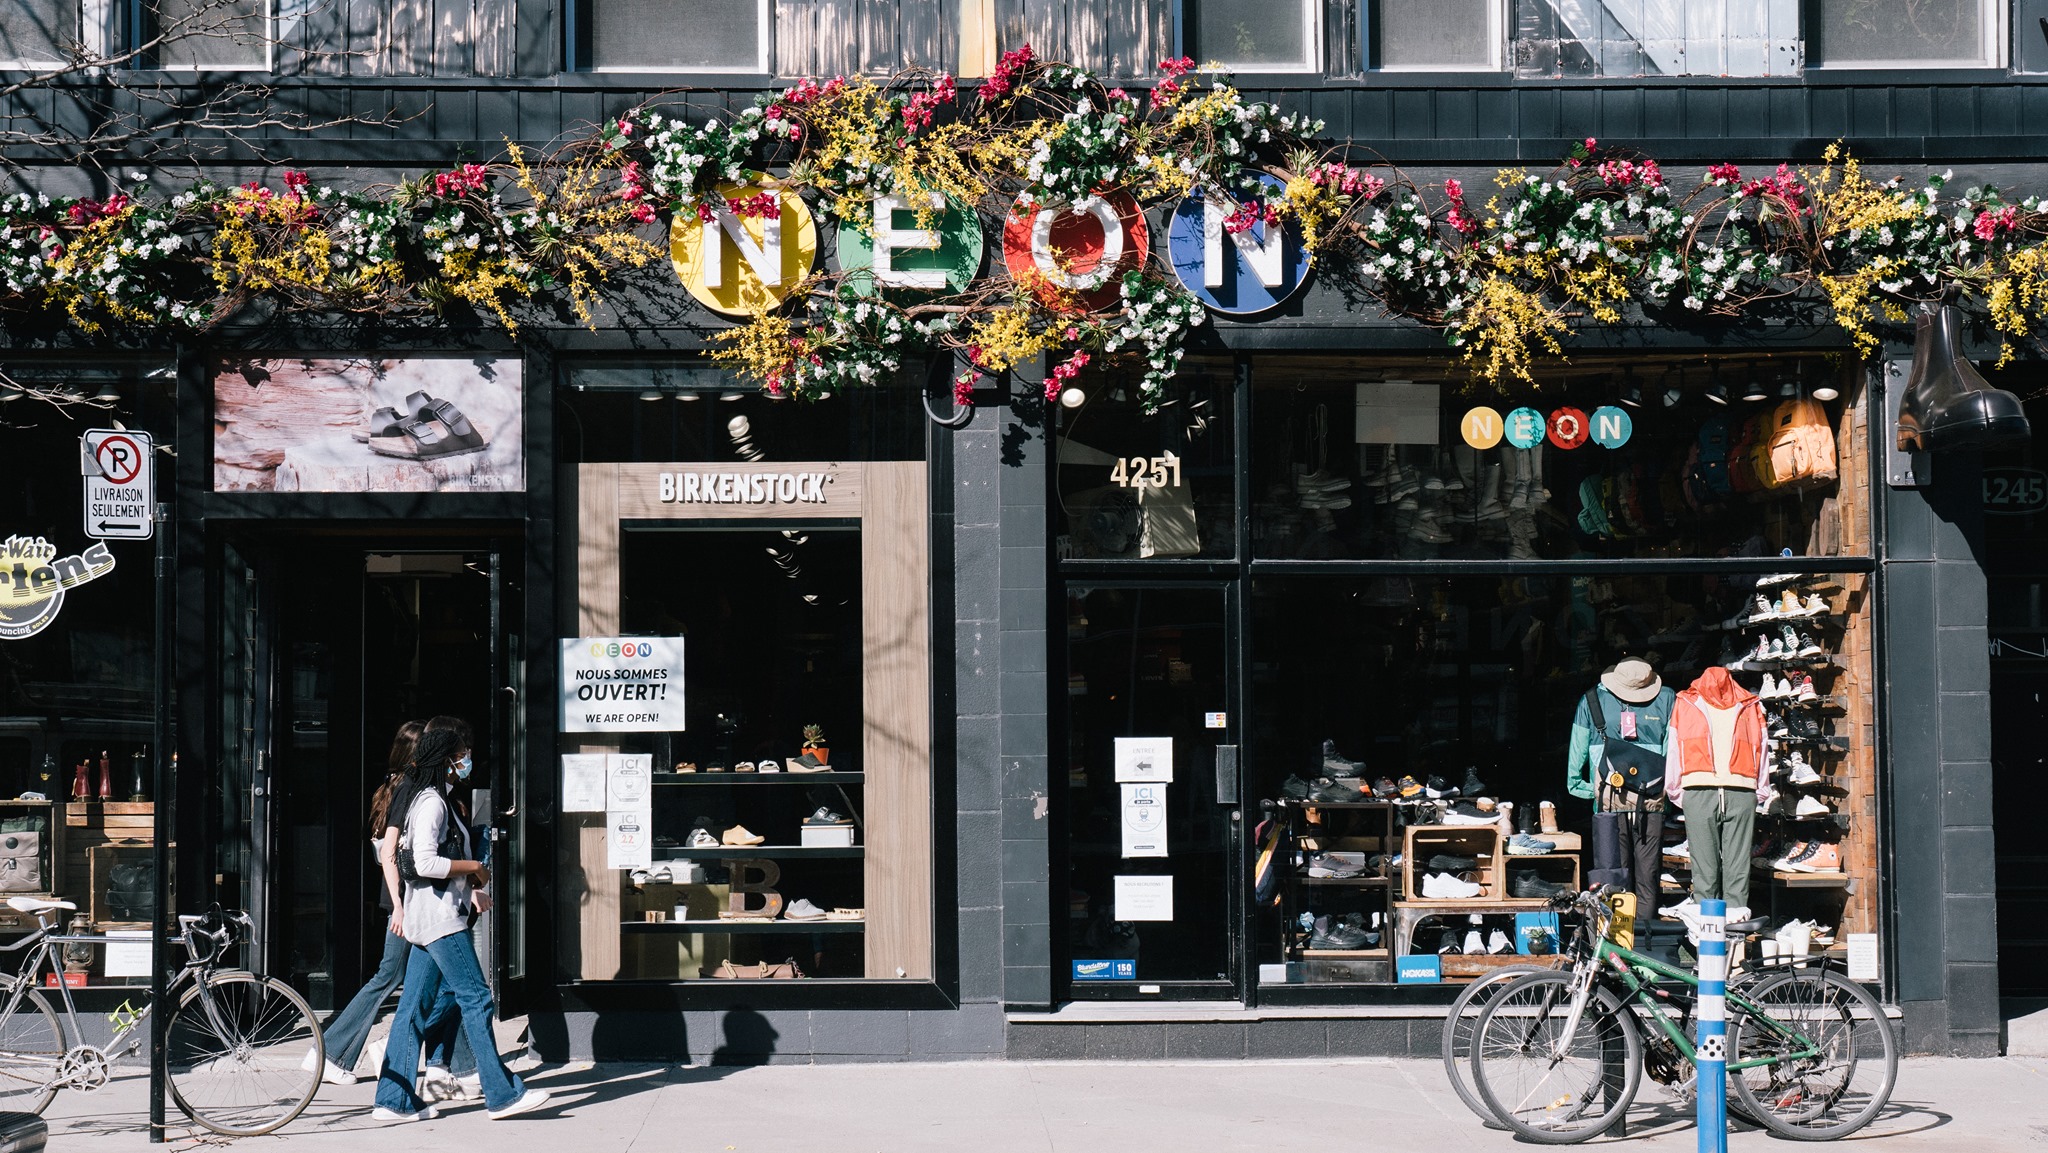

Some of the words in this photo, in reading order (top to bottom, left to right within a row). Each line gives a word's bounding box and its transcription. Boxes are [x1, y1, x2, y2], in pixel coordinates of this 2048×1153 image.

[702, 188, 1283, 291] NEON
[1470, 413, 1622, 441] NEON
[1110, 457, 1181, 488] 4251
[659, 473, 828, 502] BIRKENSTOCK
[94, 487, 143, 502] LIVRAISON
[92, 503, 145, 518] SEULEMENT
[0, 624, 32, 636] uncing
[592, 644, 650, 657] NEON
[575, 669, 611, 680] NOUS
[613, 668, 668, 680] SOMMES
[577, 683, 667, 701] OUVERT!
[585, 713, 602, 723] WE
[603, 713, 624, 723] ARE
[626, 712, 659, 723] OPEN!
[621, 759, 639, 770] ICI
[1134, 787, 1154, 799] ICI
[621, 814, 637, 824] ICI
[620, 834, 635, 844] 22
[1699, 923, 1721, 934] MTL
[1117, 963, 1132, 972] 150
